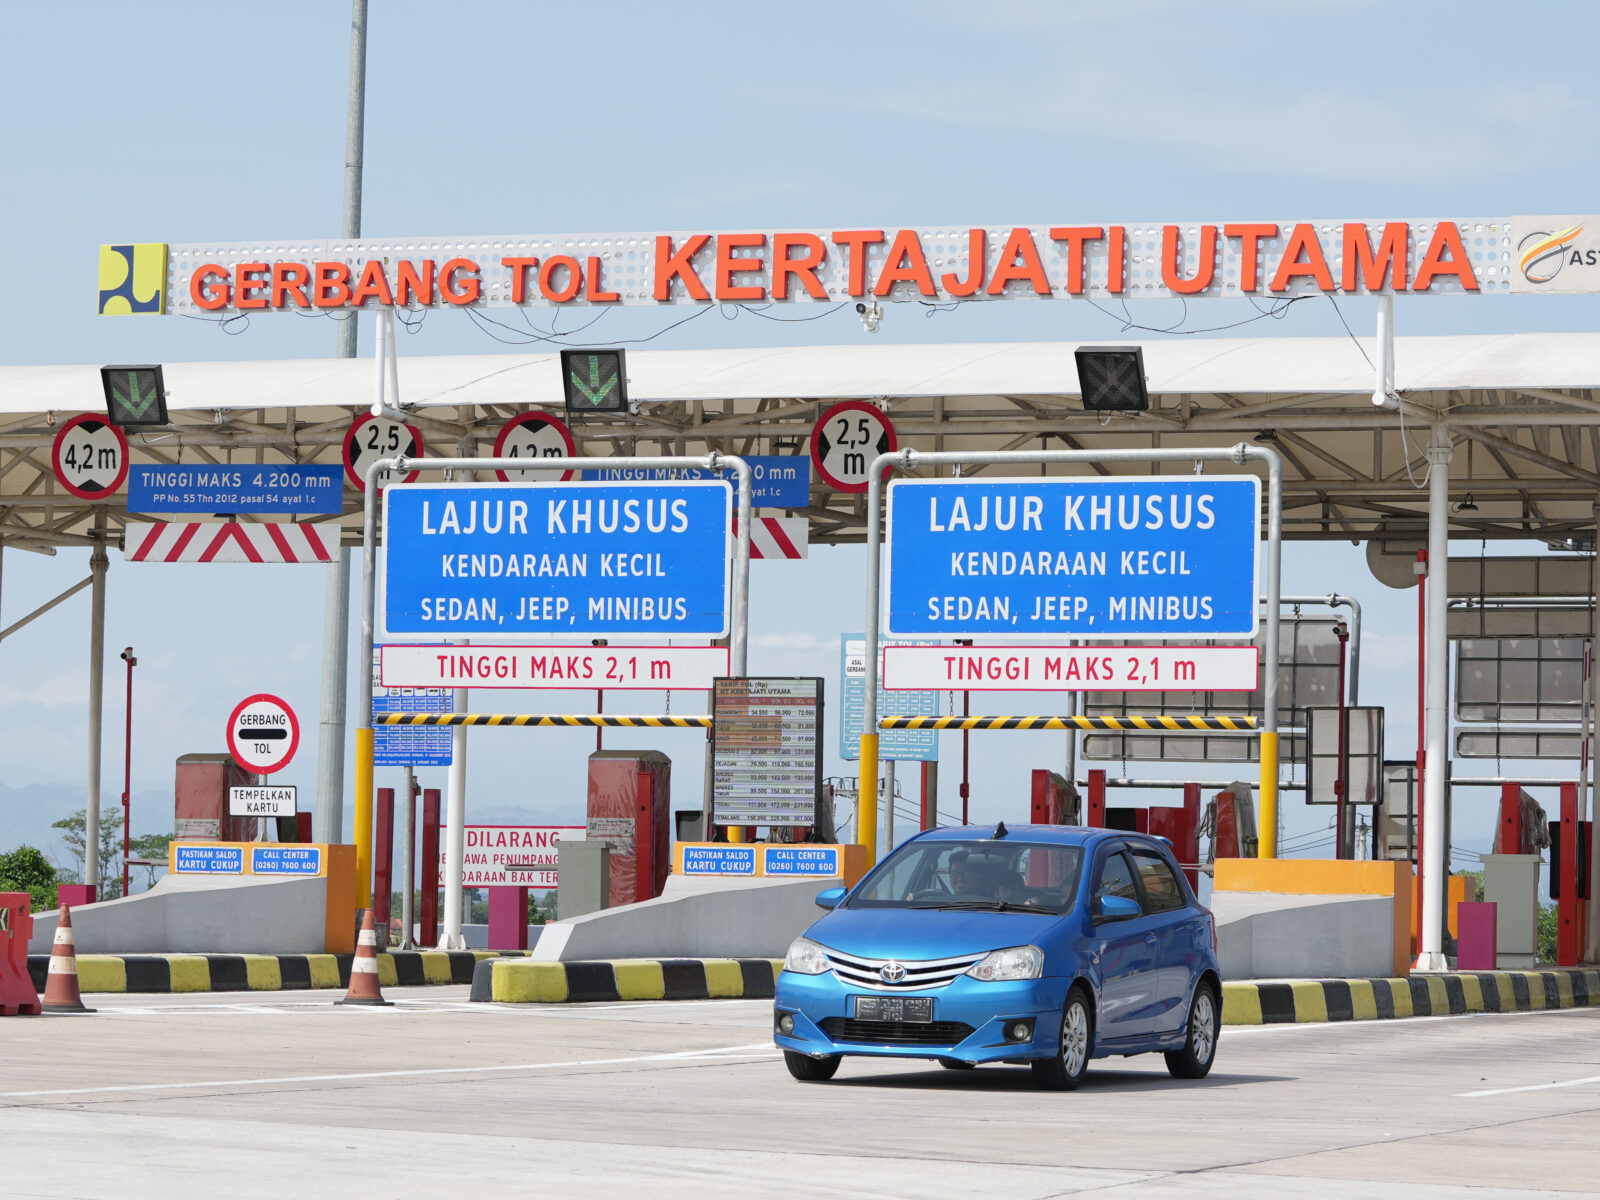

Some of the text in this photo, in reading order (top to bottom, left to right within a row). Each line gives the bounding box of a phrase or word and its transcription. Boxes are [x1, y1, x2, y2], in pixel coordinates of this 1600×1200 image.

[1569, 250, 1600, 266] AS
[190, 221, 1480, 311] GERBANG TOL KERTAJATI UTAMA
[367, 424, 399, 454] 2,5
[836, 418, 870, 450] 2,5
[65, 444, 116, 474] 4,2 m
[844, 452, 865, 475] m
[142, 473, 331, 488] TINGGI MAKS 4.200 mm
[769, 467, 796, 480] mm
[153, 494, 166, 503] PP
[167, 494, 182, 503] No.
[183, 494, 196, 503] 55
[197, 494, 213, 503] Thn
[215, 494, 237, 503] 2012
[240, 494, 265, 505] pasal
[266, 494, 279, 503] 54
[282, 494, 302, 505] ayat
[422, 498, 689, 535] LAJUR KHUSUS
[930, 494, 1216, 532] LAJUR KHUSUS
[442, 553, 666, 578] KENDARAAN KECIL
[951, 551, 1191, 576] KENDARAAN KECIL
[421, 597, 688, 625] SEDAN, JEEP, MINIBUS
[928, 596, 1214, 625] SEDAN, JEEP, MINIBUS
[436, 655, 671, 682] TINGGI MAKS 2,1 m
[944, 656, 1196, 684] TINGGI MAKS 2,1 m
[240, 714, 286, 725] GERBANG
[254, 743, 271, 754] TOL
[233, 790, 292, 800] TEMPELKAN
[246, 802, 279, 813] KARTU
[467, 831, 560, 848] DILARANG
[181, 850, 237, 859] PASTIKAN SALDO
[283, 851, 309, 859] CENTER
[689, 850, 749, 860] PASTIKAN SALDO
[776, 851, 826, 860] CALL CENTER
[179, 860, 239, 869] KARTU CUKUP
[255, 861, 317, 870] (0260) 7600 600
[686, 861, 752, 871] KARTU CUKUP
[768, 863, 834, 872] (0260) 7600 600
[511, 872, 533, 883] BAK
